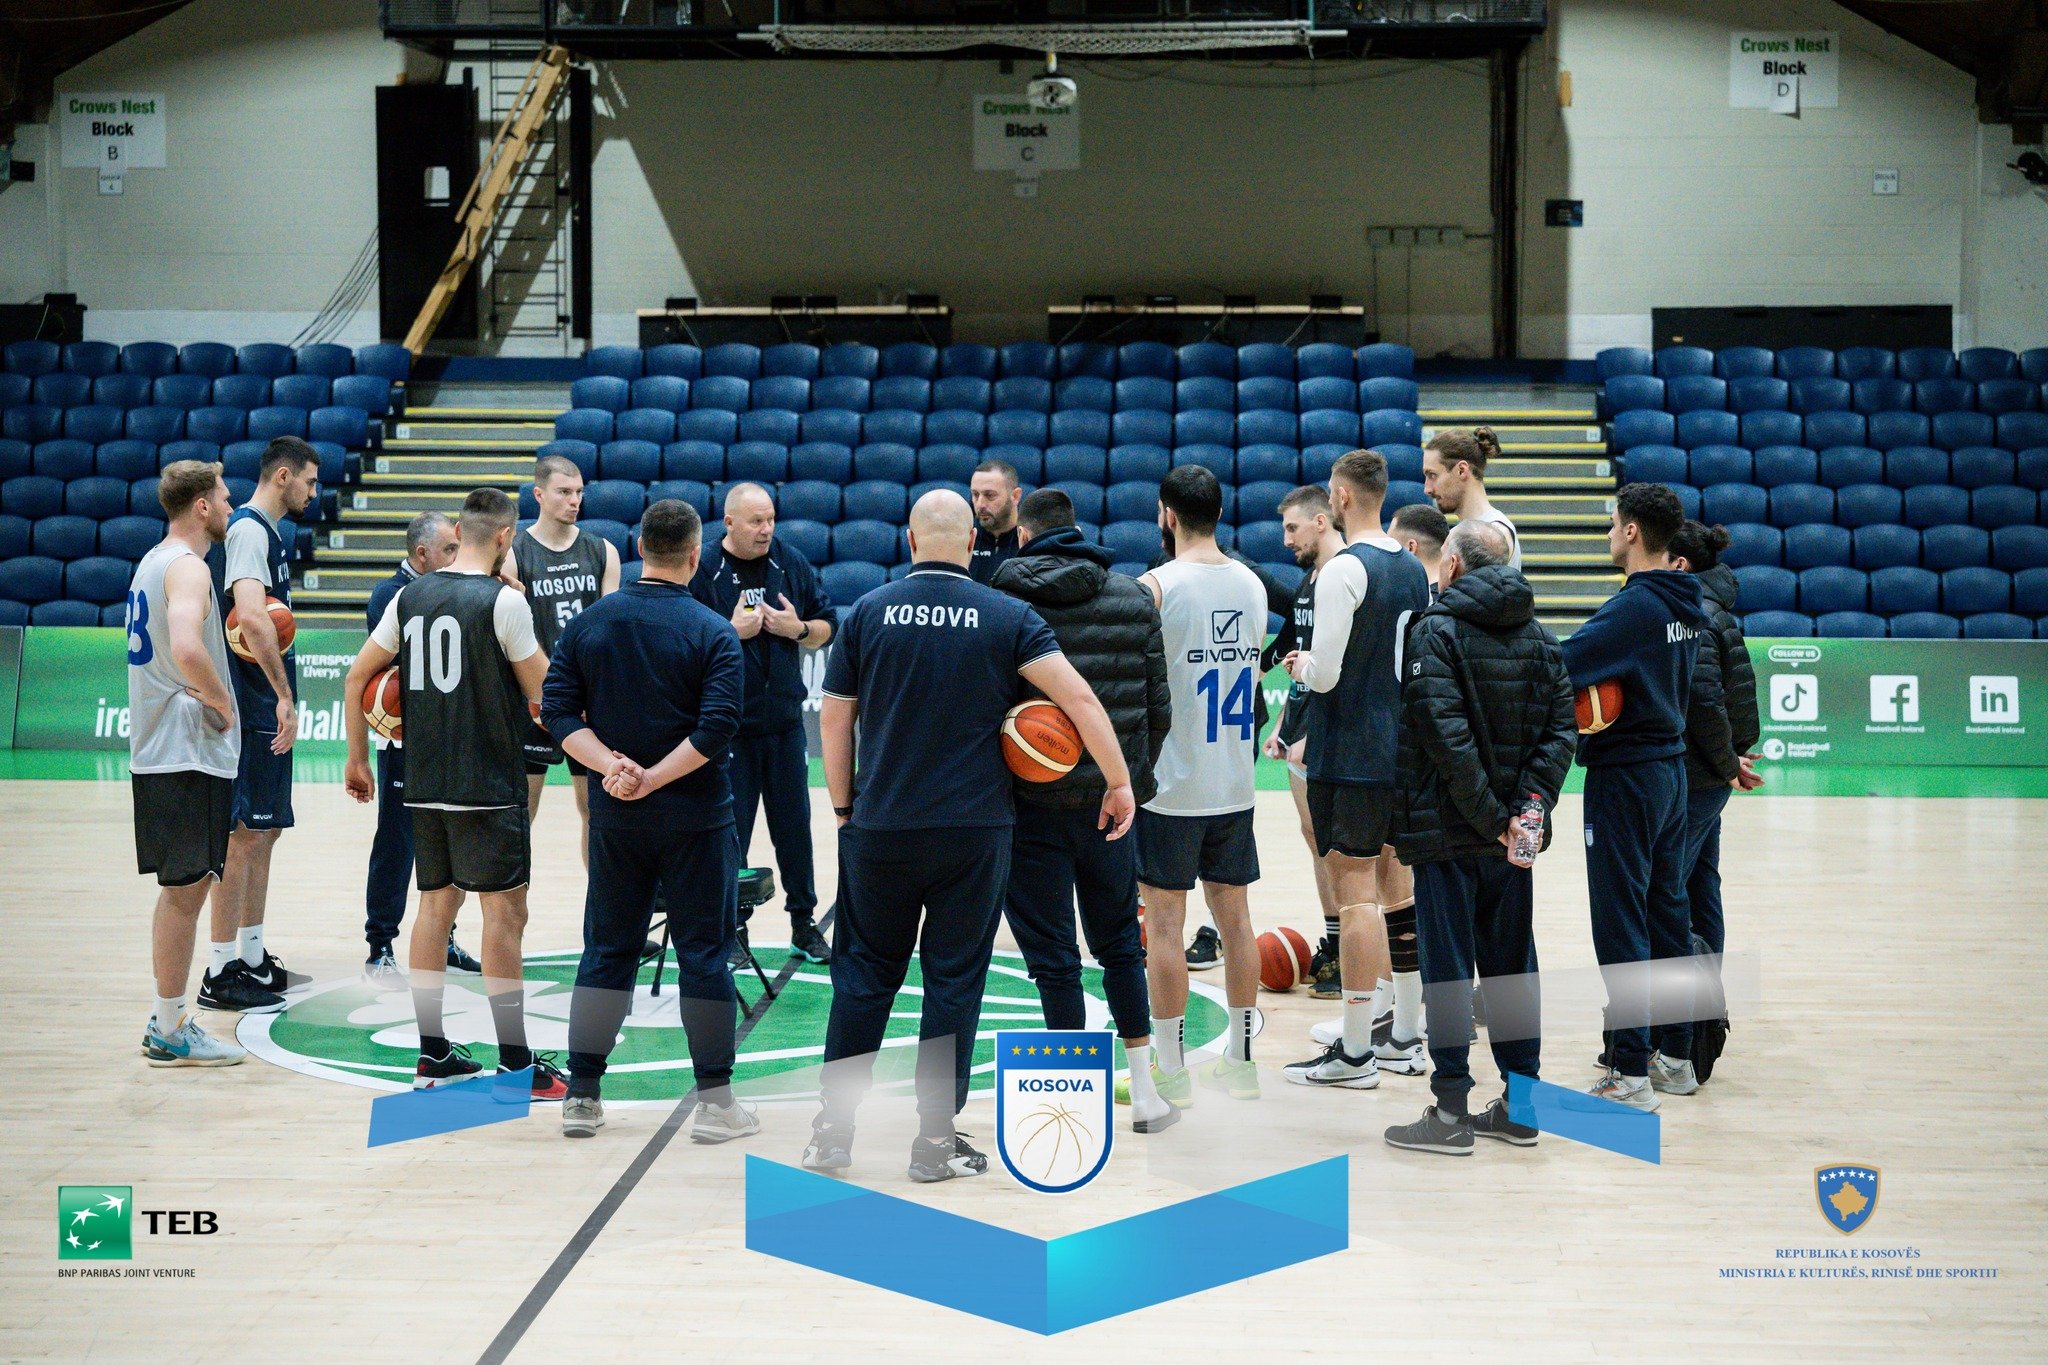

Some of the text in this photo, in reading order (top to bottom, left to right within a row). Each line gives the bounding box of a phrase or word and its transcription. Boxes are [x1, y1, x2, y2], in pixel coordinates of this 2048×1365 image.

[1741, 38, 1830, 53] Crows Nest
[1763, 61, 1807, 75] Block
[1777, 82, 1790, 97] D
[69, 99, 156, 114] Crows Nest
[983, 101, 1031, 115] Crows
[92, 121, 134, 136] Block
[1005, 123, 1048, 138] Block
[108, 145, 119, 160] B
[1021, 146, 1034, 161] C
[547, 563, 579, 572] GIVOVA
[532, 574, 596, 597] KOSOVA
[883, 604, 979, 628] KOSOVA
[403, 615, 462, 693] 10
[1187, 647, 1261, 663] GIVOVA
[1773, 650, 1817, 658] FOLLOW US
[303, 666, 341, 680] Elverys
[1197, 666, 1254, 743] 14
[95, 697, 130, 738] ire
[1036, 730, 1069, 755] molten
[1788, 742, 1830, 751] Basketball
[1788, 750, 1816, 758] Ireland
